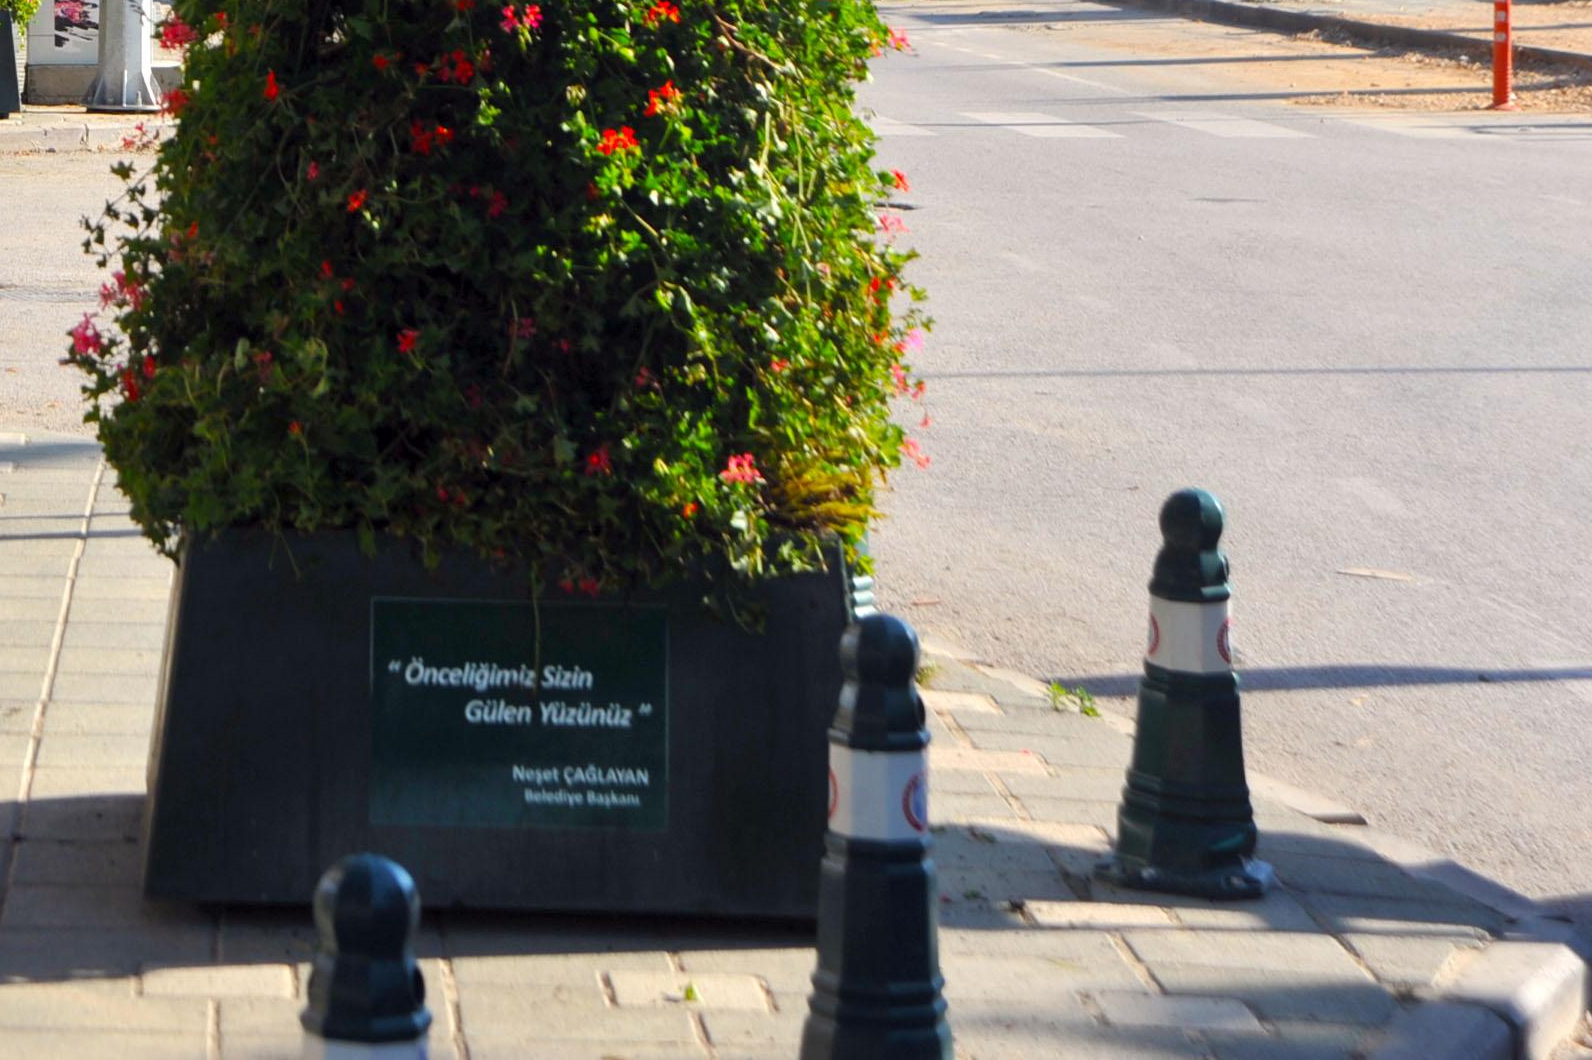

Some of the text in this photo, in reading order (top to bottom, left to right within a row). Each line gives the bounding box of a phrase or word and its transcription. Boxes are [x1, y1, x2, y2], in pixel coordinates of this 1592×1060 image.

[540, 664, 593, 690] Sizin
[464, 698, 532, 724] Gülen
[539, 700, 633, 728] Yüzünüz
[512, 763, 650, 787] Neşet ÇAĞLAYAN
[524, 788, 641, 808] Belediye Başkanı
